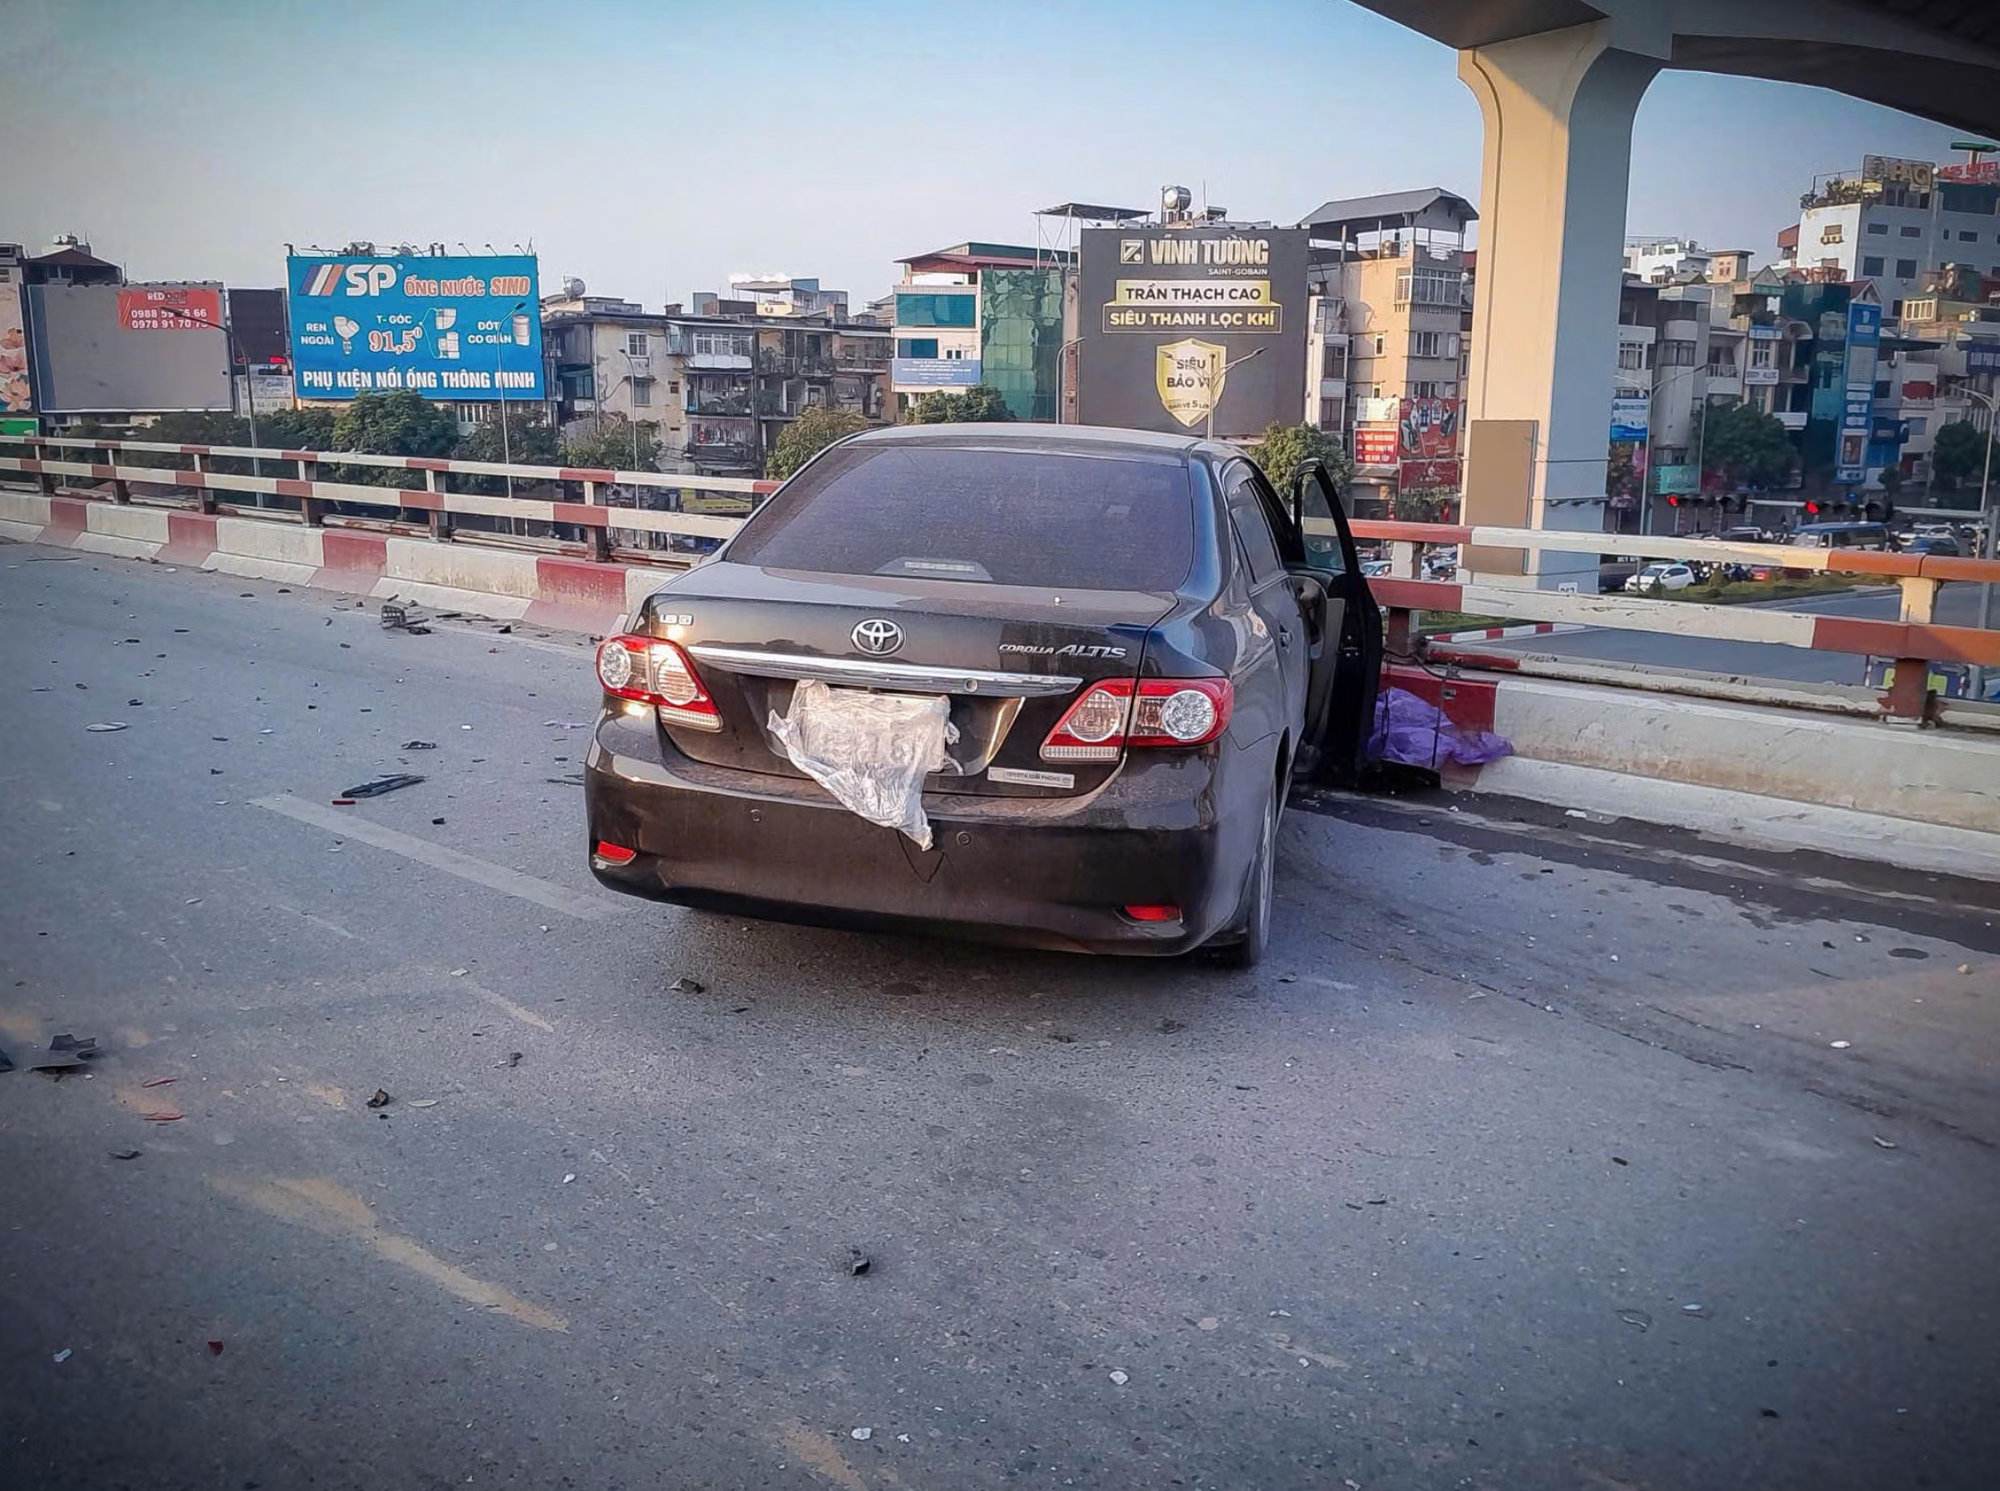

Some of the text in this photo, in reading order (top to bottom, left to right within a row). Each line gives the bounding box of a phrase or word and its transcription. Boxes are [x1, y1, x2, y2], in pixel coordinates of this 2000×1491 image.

[1201, 234, 1269, 265] TƯỜNG
[1208, 268, 1268, 276] SAINT-GOBAIN
[346, 264, 397, 296] SP
[404, 275, 530, 297] ỐNG NƯỚC SINO
[1172, 288, 1225, 303] THẠCH
[1229, 288, 1261, 300] CAO
[131, 309, 157, 318] 0988
[1110, 310, 1275, 329] SIÊU THANH LỌC KHÍ
[132, 319, 158, 329] 0978
[162, 319, 174, 328] 91
[178, 319, 191, 328] 70
[306, 323, 327, 332] REN
[467, 334, 484, 344] CO
[303, 371, 333, 391] PHỤ
[337, 368, 372, 391] KIỆN
[375, 366, 403, 388] NỐI
[406, 366, 437, 388] ỐNG
[441, 368, 490, 388] THÔNG
[494, 371, 535, 388] MINH
[999, 644, 1127, 658] COROLLA ALTIS
